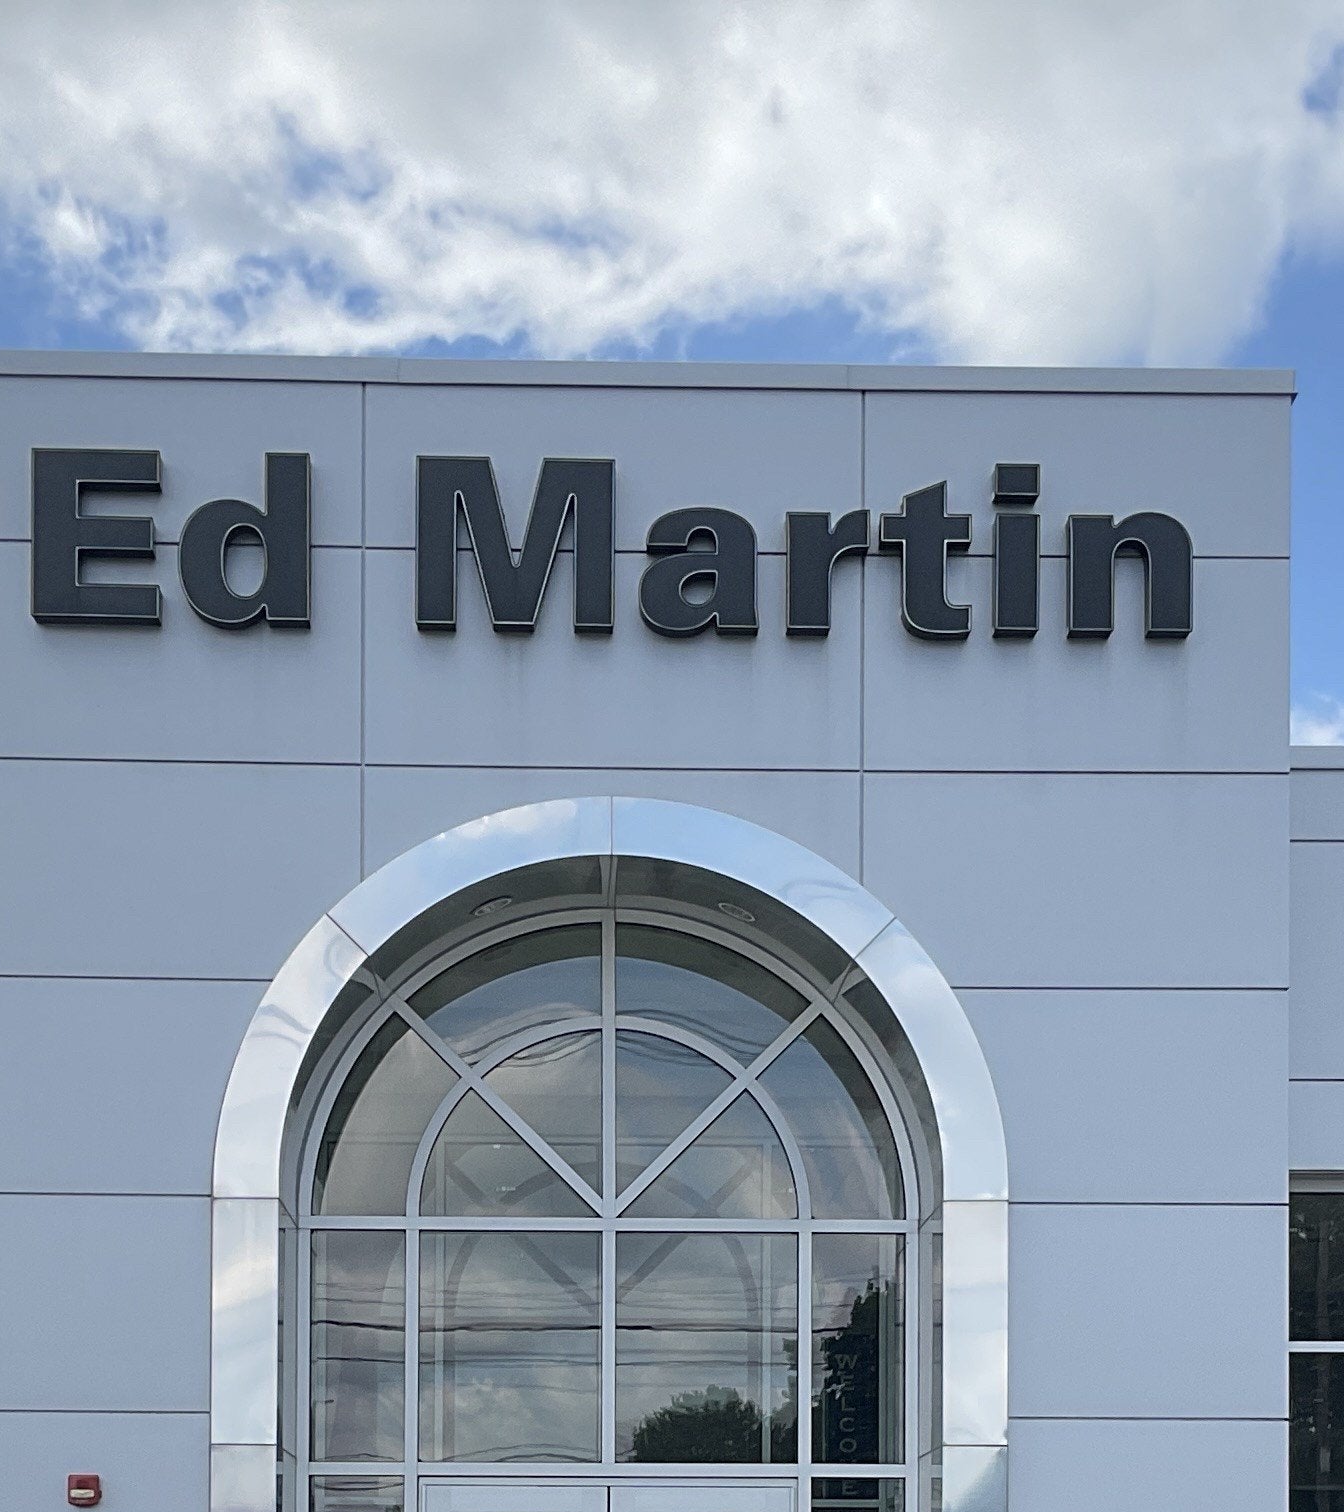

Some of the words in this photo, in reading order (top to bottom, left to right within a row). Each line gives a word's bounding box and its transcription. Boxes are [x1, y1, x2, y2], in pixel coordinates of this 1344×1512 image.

[31, 447, 312, 629] Ed
[415, 454, 1194, 641] Martin
[834, 1353, 858, 1496] WELCOE
